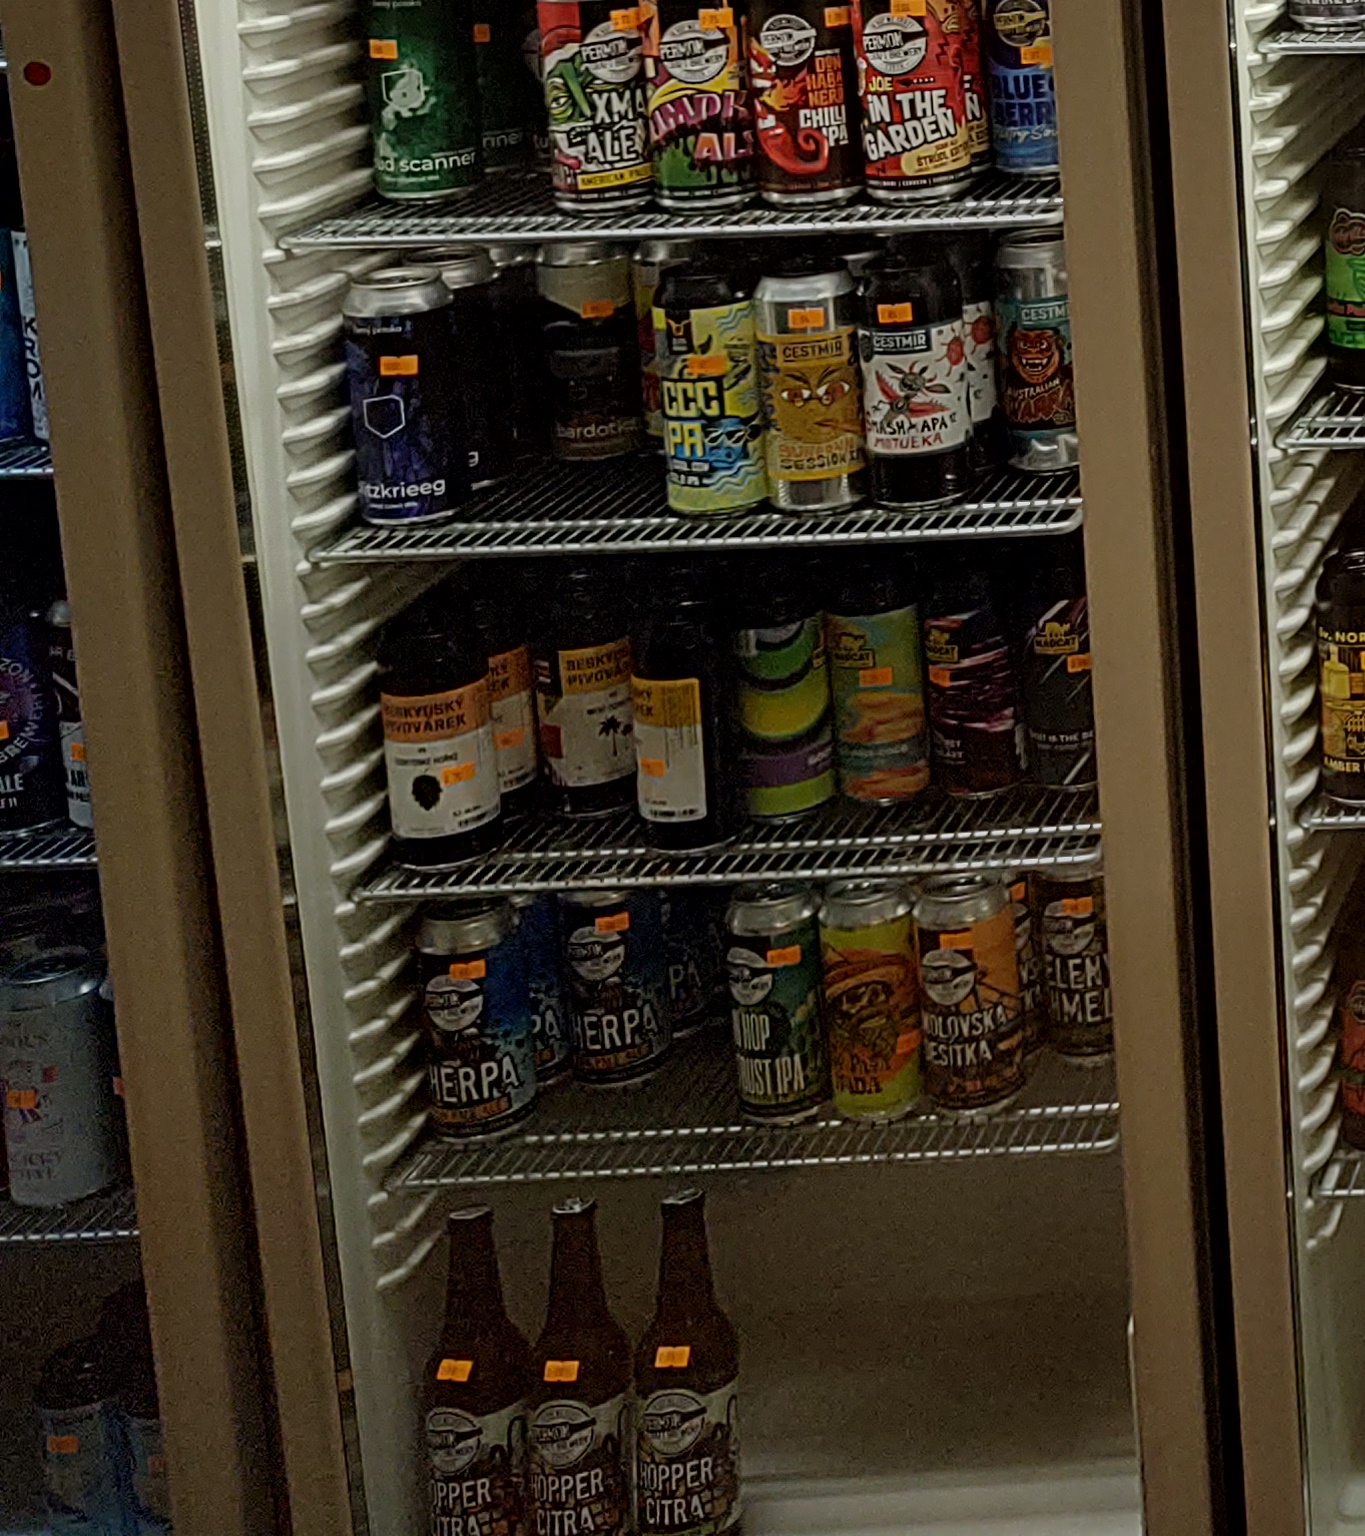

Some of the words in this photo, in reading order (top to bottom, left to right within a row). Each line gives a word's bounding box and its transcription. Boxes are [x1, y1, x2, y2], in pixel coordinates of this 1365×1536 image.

[868, 76, 893, 92] JOE
[592, 90, 649, 123] XMA
[896, 89, 947, 117] THE
[865, 109, 957, 161] GARDEN
[399, 149, 476, 172] scanner
